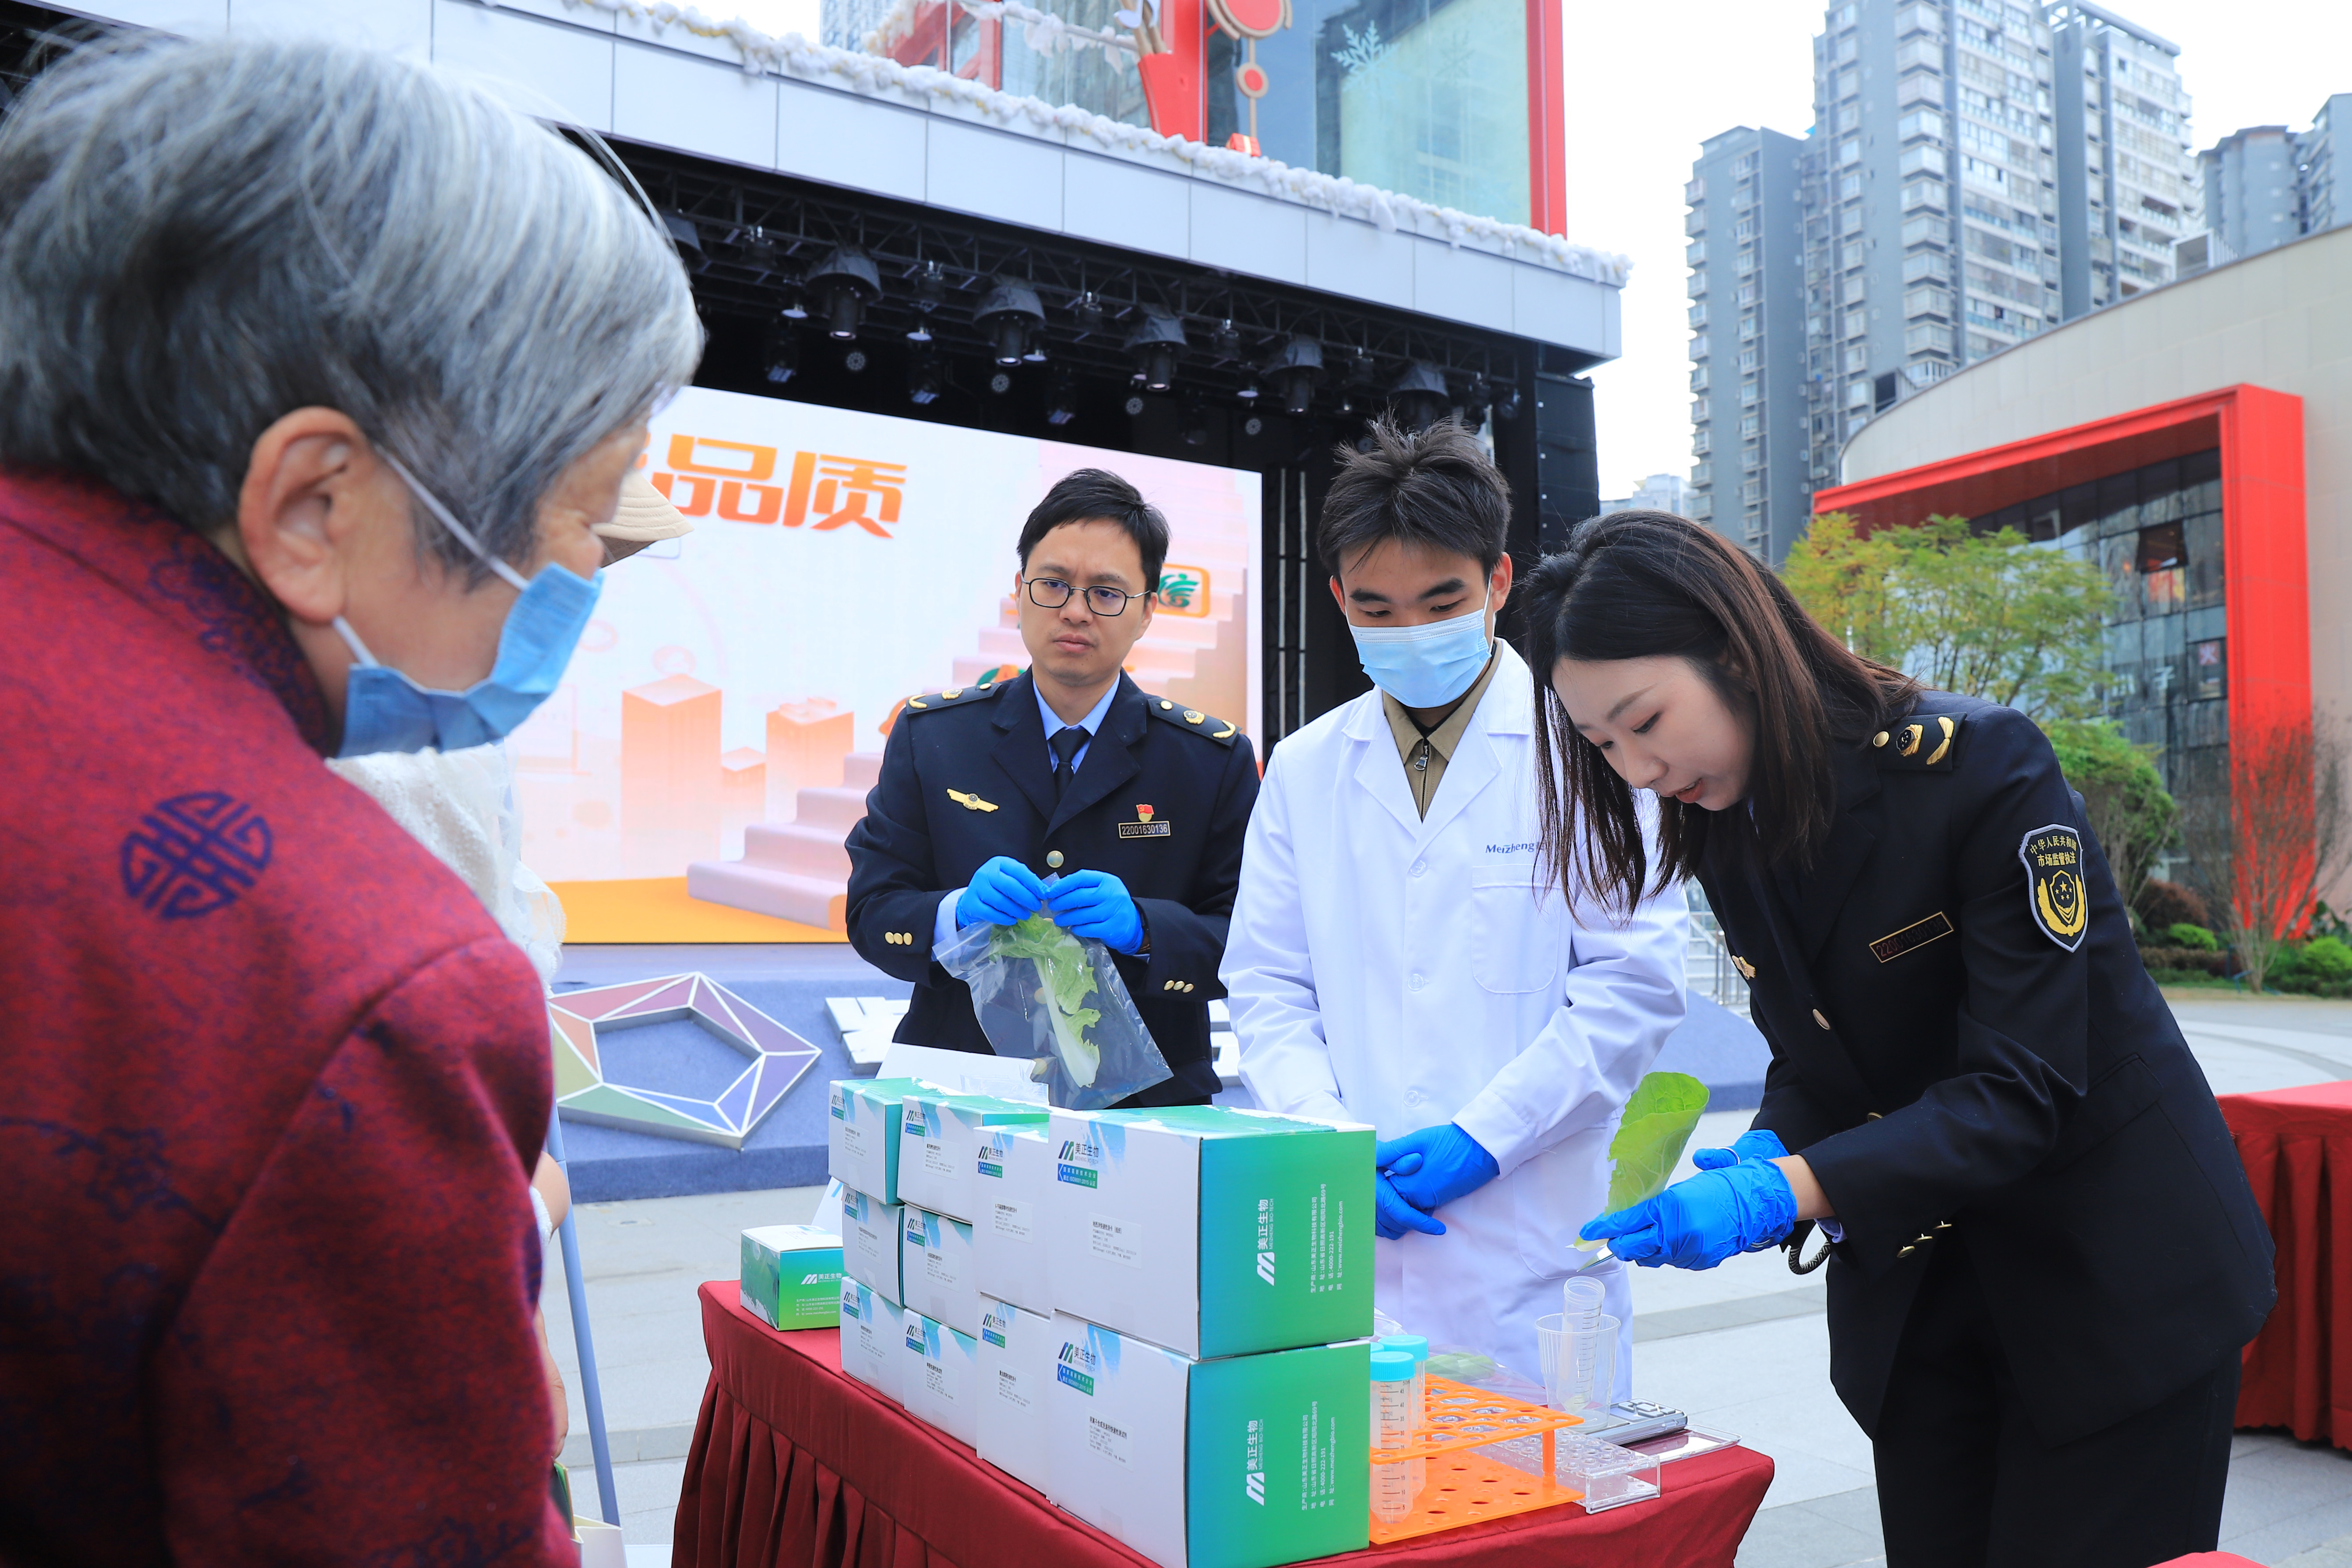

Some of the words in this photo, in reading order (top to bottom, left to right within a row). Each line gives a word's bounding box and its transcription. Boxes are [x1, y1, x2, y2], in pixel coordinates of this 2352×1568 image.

[634, 433, 907, 539] 品质
[1121, 824, 1168, 835] 22001630136
[1485, 843, 1535, 854] Meizheng
[2030, 835, 2077, 855] 中华人民共和国
[2037, 851, 2076, 867] 市场监管执法
[1876, 917, 1946, 957] 22001630136
[988, 1148, 1003, 1158] 美正生物
[1075, 1142, 1099, 1158] 美正生物
[1257, 1199, 1268, 1250] 美正生物
[992, 1316, 1006, 1328] 美正生物
[1074, 1346, 1096, 1365] 美正生物
[1247, 1420, 1258, 1471] 美正生物
